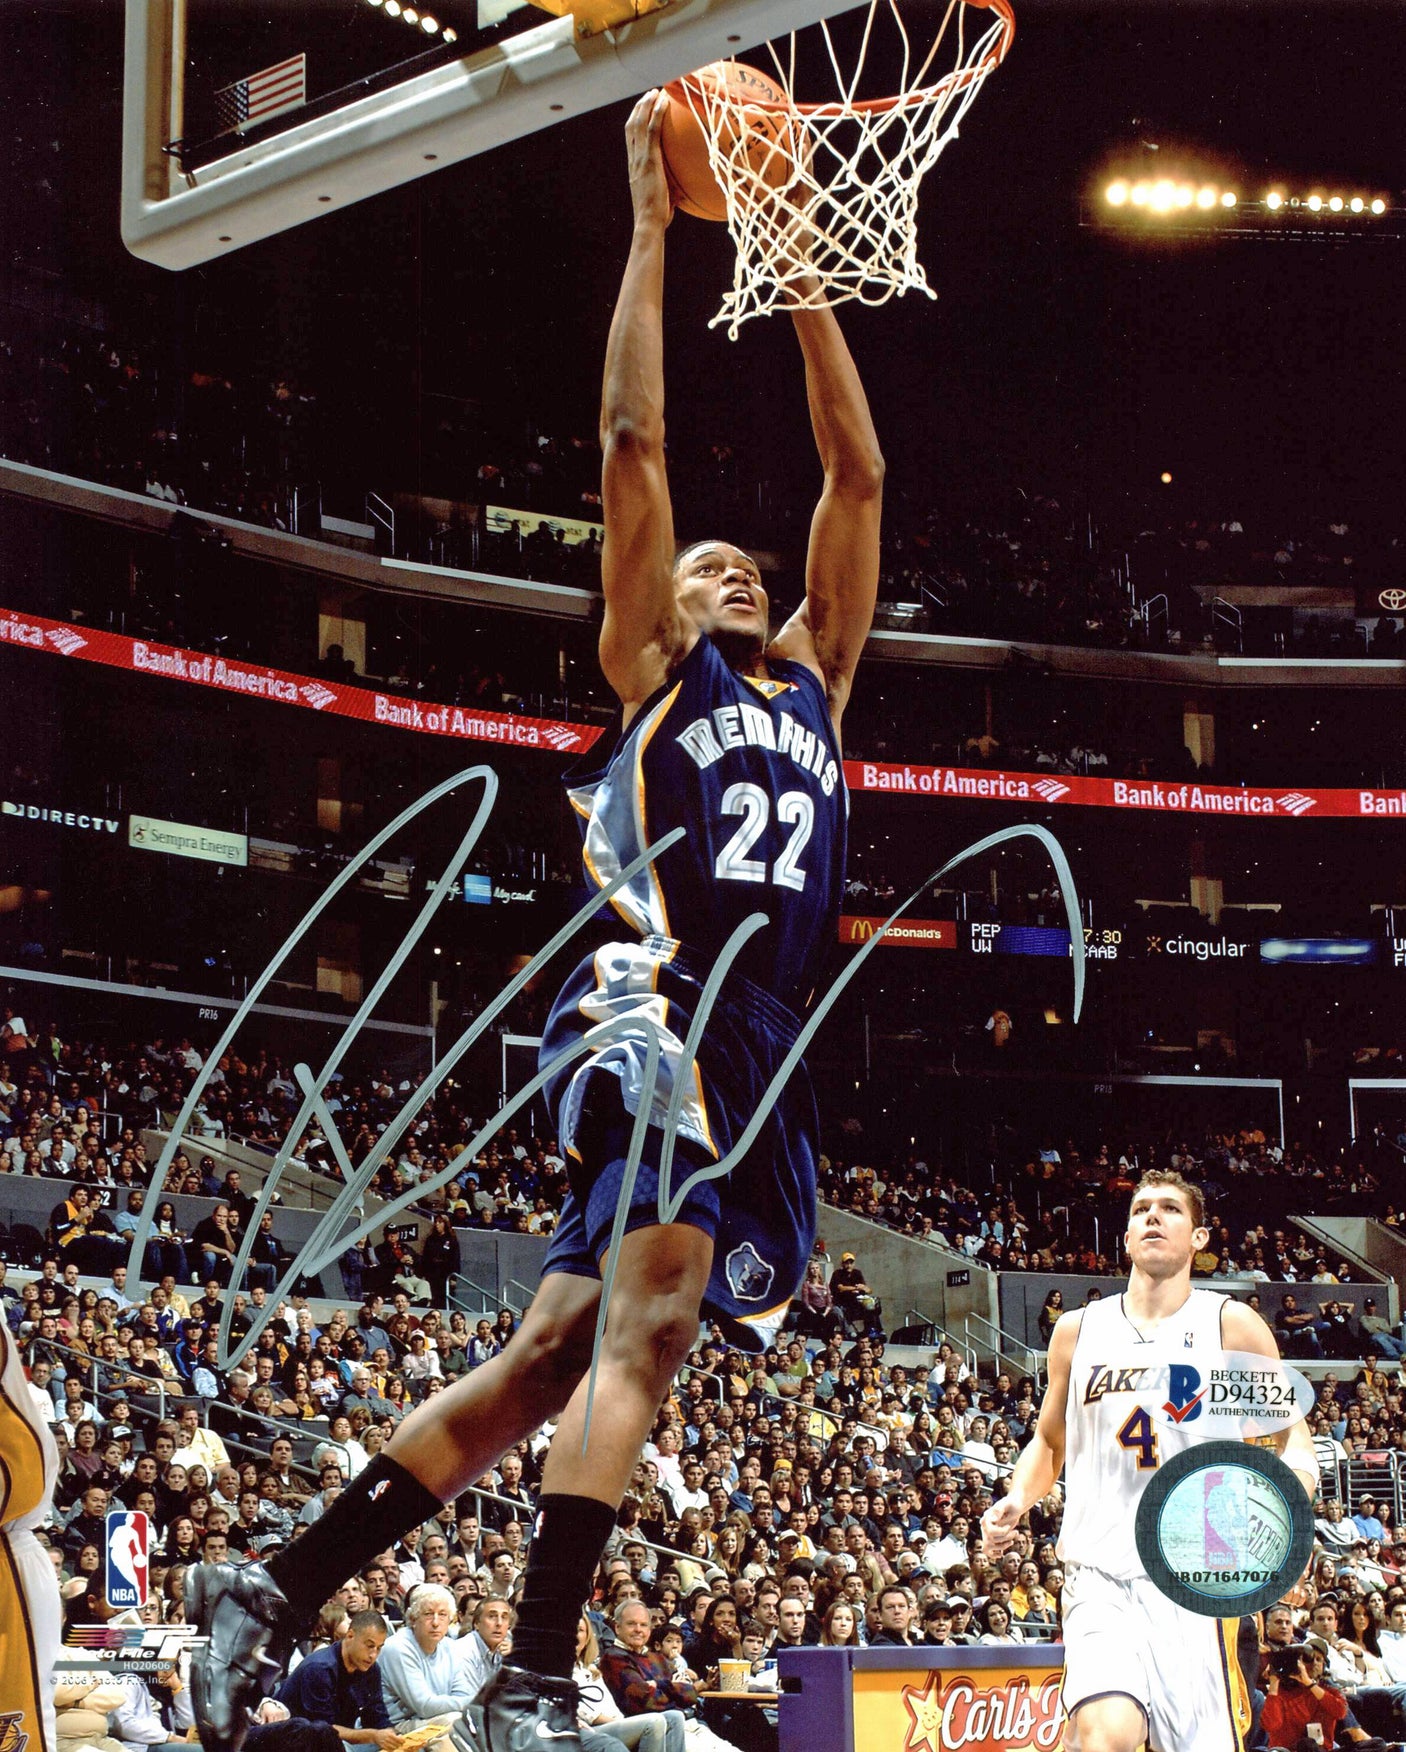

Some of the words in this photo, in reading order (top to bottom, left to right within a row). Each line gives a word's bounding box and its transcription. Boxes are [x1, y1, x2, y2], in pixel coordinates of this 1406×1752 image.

[132, 641, 188, 678] Bank
[189, 656, 213, 681] of
[213, 660, 298, 701] America
[374, 695, 424, 728] Bank
[425, 708, 450, 731] of
[450, 709, 539, 744] America
[675, 702, 839, 797] MEMPHIS
[863, 764, 918, 791] Bank
[919, 769, 941, 792] of
[943, 770, 1030, 799] America
[1113, 781, 1165, 806] Bank
[1167, 786, 1188, 809] of
[1190, 787, 1275, 813] America
[27, 805, 120, 834] DIRECTV
[151, 828, 199, 851] Sempra
[201, 840, 242, 859] Energy
[714, 782, 815, 892] 22
[971, 923, 1001, 938] PEP
[971, 939, 993, 953] UW
[1165, 934, 1247, 961] cingular
[199, 1007, 219, 1021] PR16
[1116, 1404, 1160, 1472] 4
[941, 1683, 1037, 1750] Carl's
